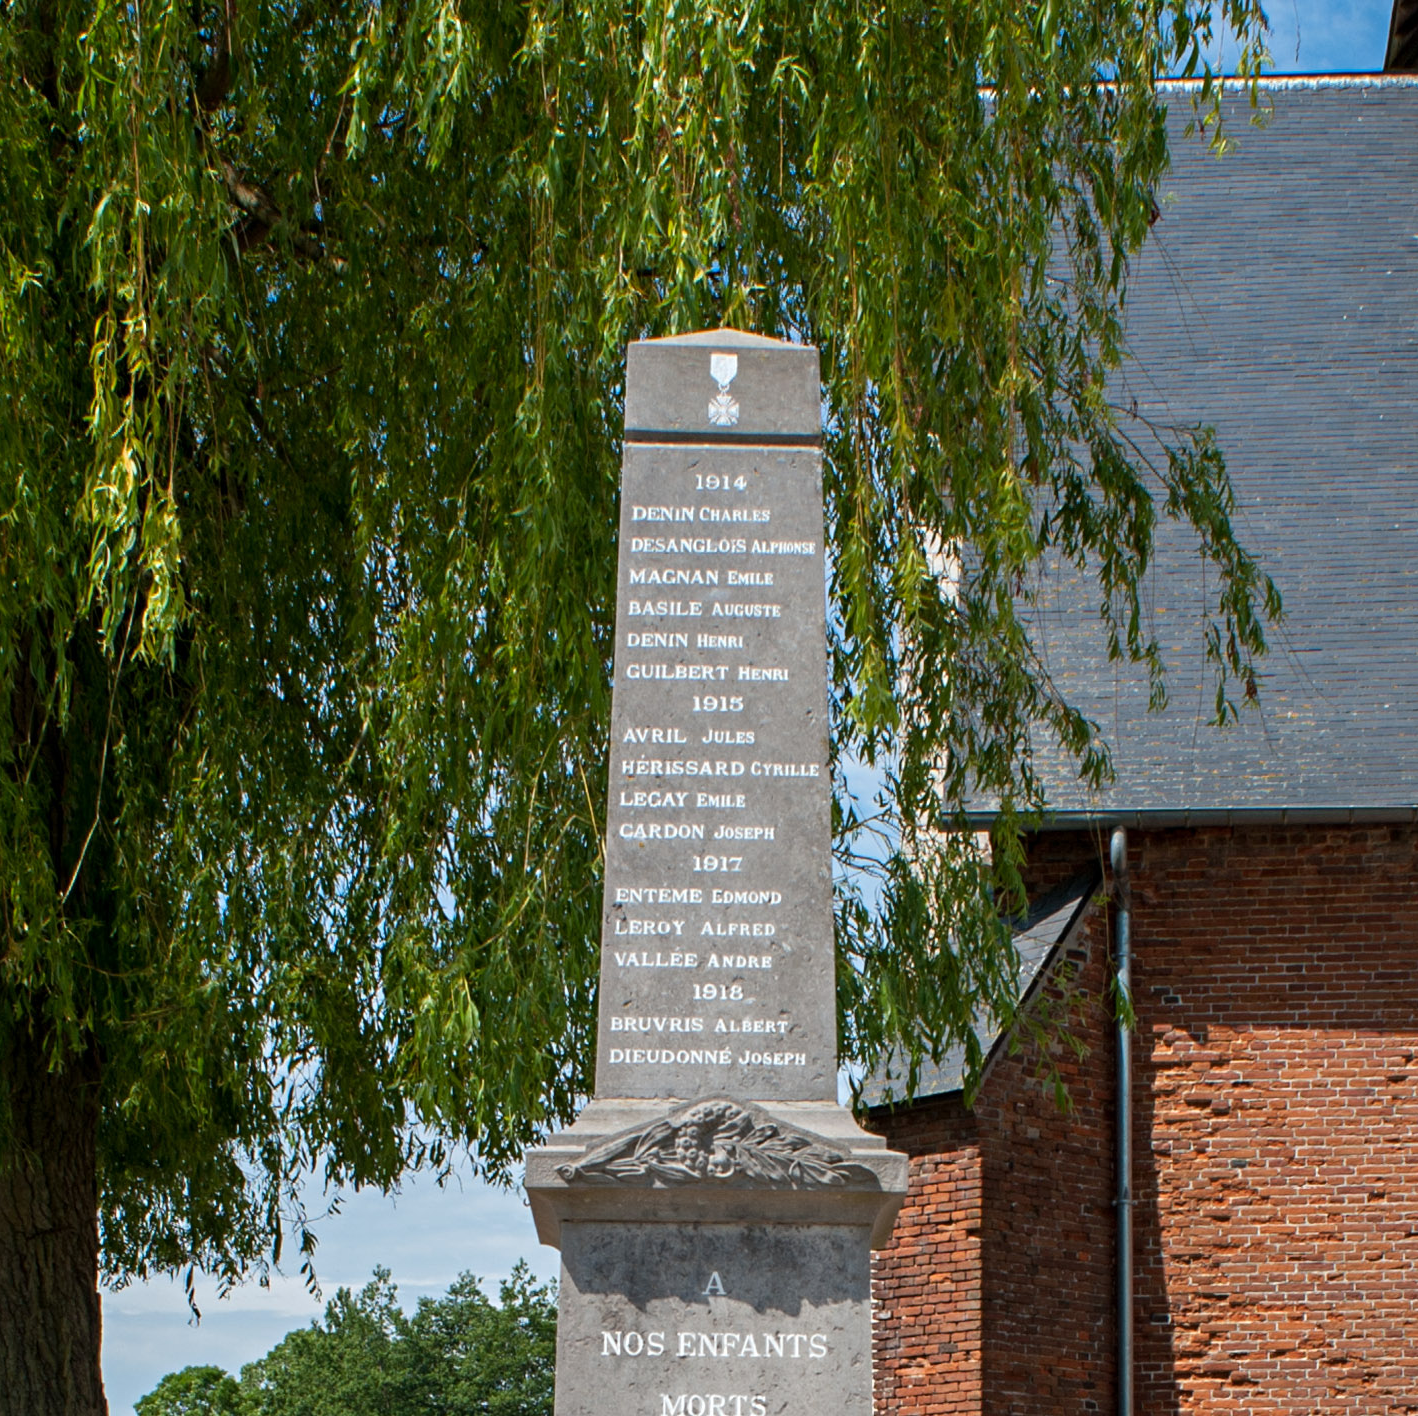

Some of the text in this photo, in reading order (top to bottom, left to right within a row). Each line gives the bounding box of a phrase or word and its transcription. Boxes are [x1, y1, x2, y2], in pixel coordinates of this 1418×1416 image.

[695, 473, 748, 491] 1914
[631, 505, 696, 522] DENIN
[630, 536, 747, 554] DESANGLOIS
[628, 568, 719, 586] MAGNAN
[628, 601, 703, 617] BASILE
[626, 633, 689, 649] DENIN
[625, 664, 729, 680] GUILBERT
[692, 696, 744, 712] 1915
[622, 728, 687, 745] AVRIL
[619, 792, 689, 808] LEGAY
[619, 824, 705, 840] CARDON
[692, 855, 743, 873] 1917
[614, 920, 685, 936] LEROY
[692, 983, 744, 1001] 1918
[610, 1017, 704, 1033] BRUVRIS
[608, 1047, 732, 1065] DIEUDONNÉ
[701, 1271, 727, 1296] A
[600, 1330, 829, 1359] NOS ENFANTS
